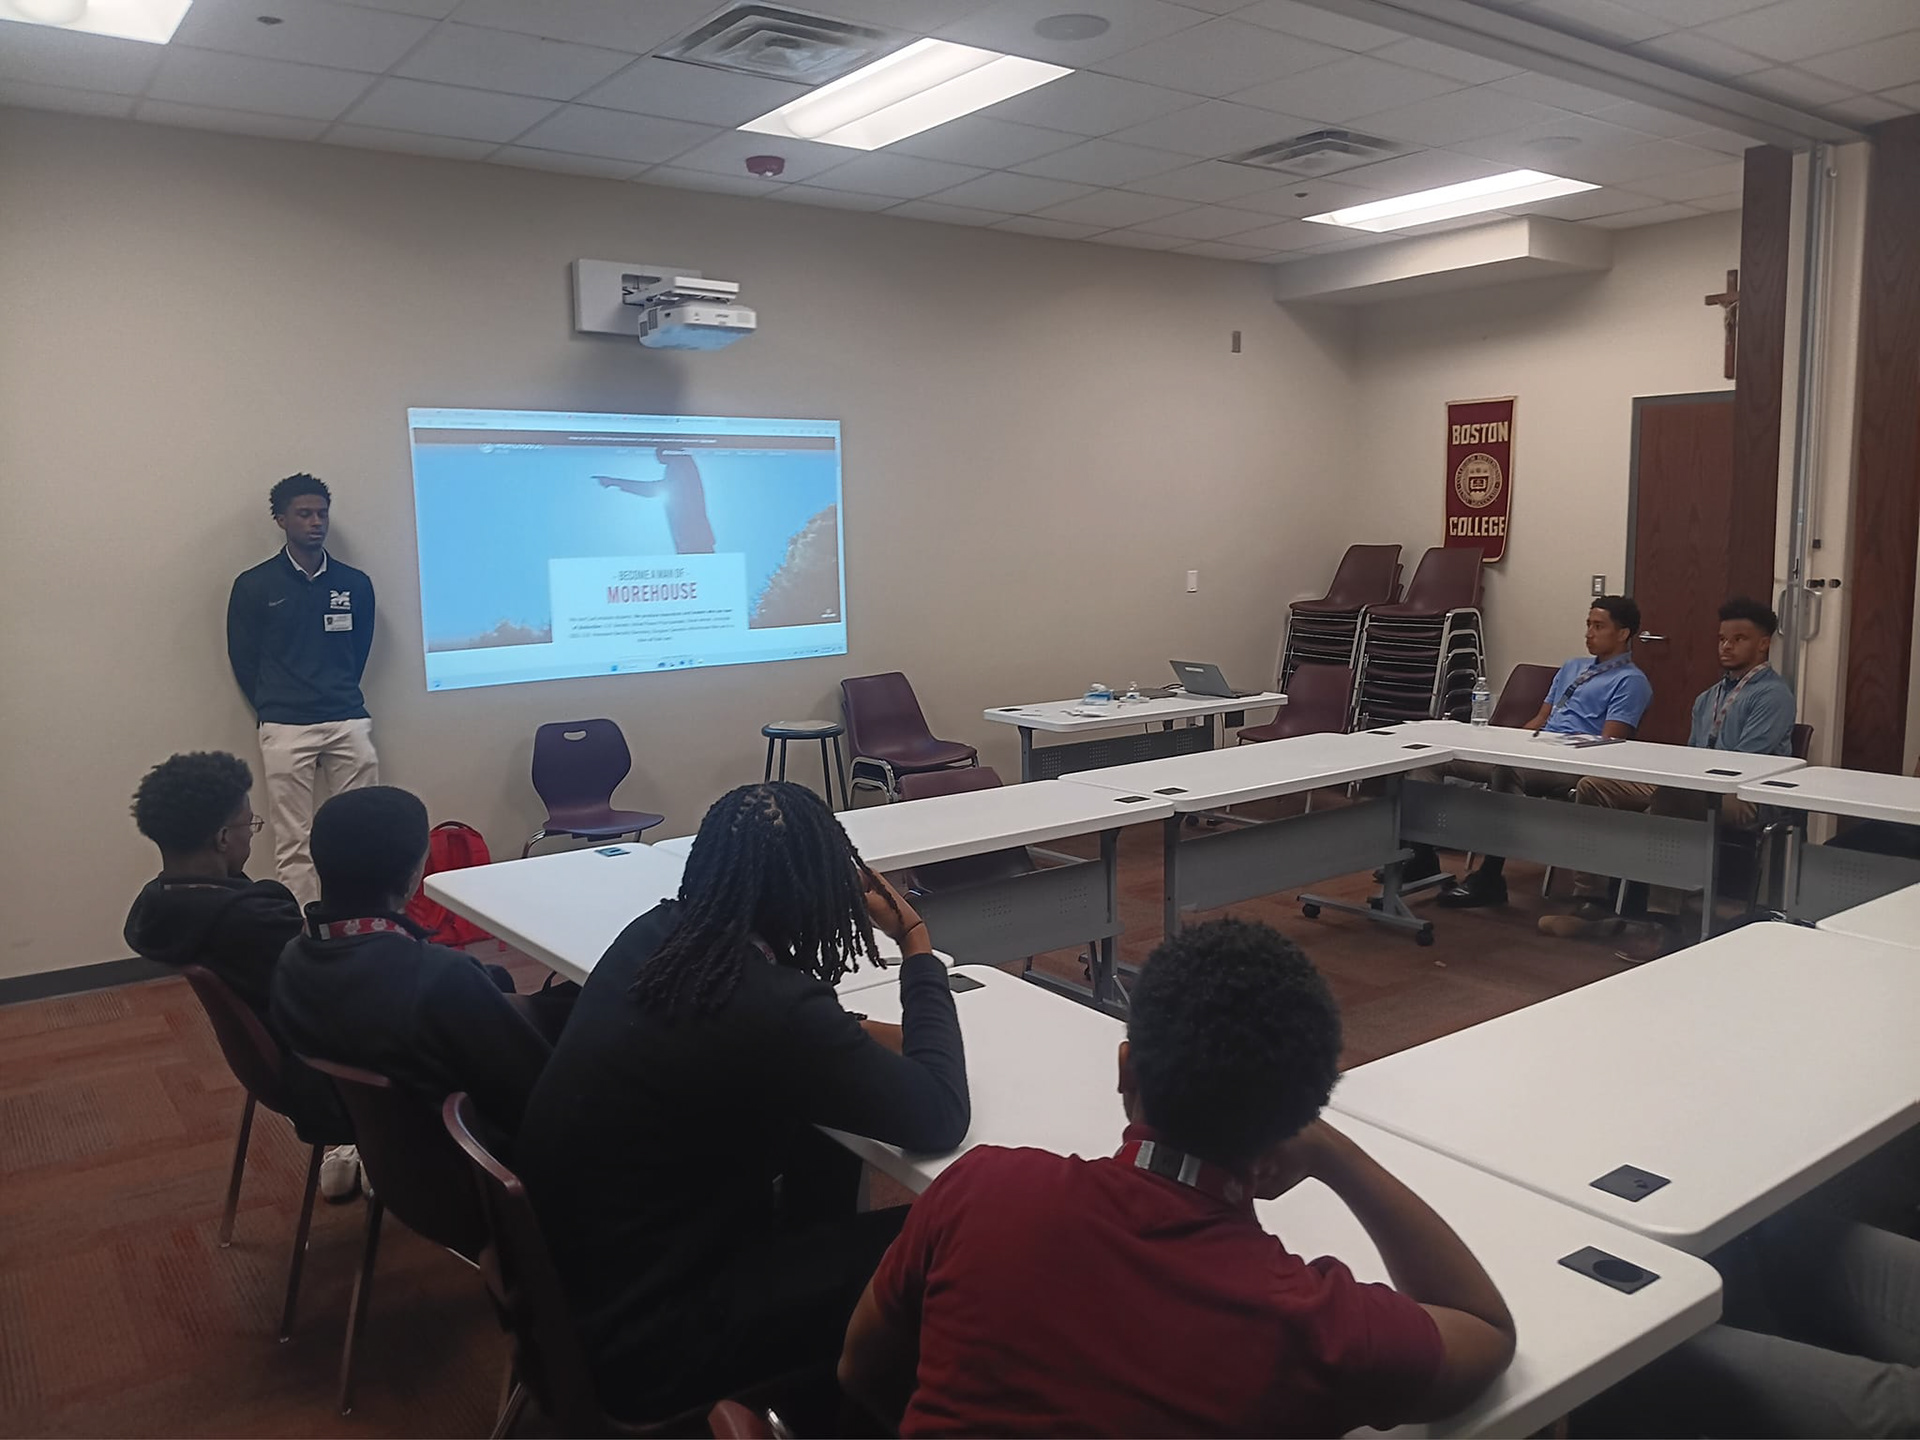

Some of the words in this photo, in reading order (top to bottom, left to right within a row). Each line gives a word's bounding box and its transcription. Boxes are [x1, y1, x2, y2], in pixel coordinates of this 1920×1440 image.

[1452, 421, 1509, 445] BOSTON
[1449, 516, 1505, 537] COLLEGE
[607, 582, 698, 604] MOREHOUSE
